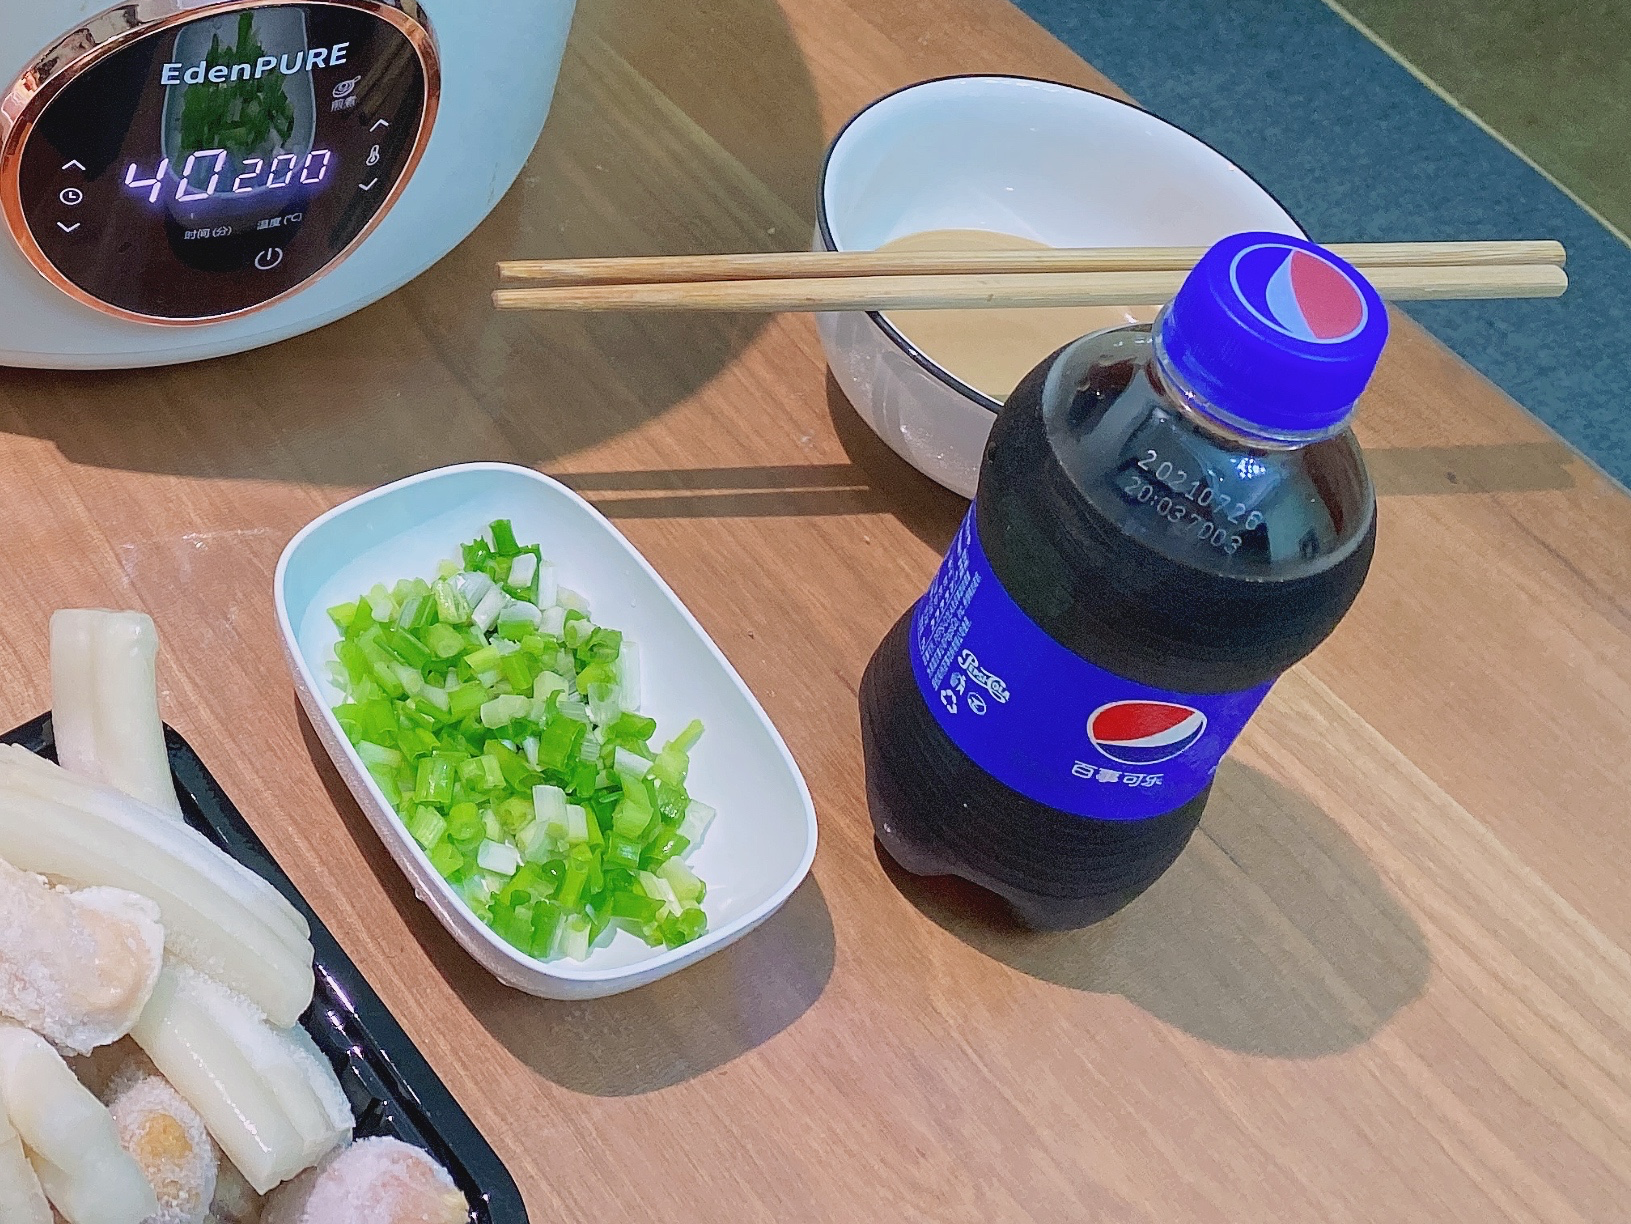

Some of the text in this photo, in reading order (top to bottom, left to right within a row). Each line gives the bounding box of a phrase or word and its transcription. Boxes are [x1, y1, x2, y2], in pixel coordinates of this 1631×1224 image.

[160, 41, 350, 85] EdenPURE
[124, 148, 332, 204] 40 200
